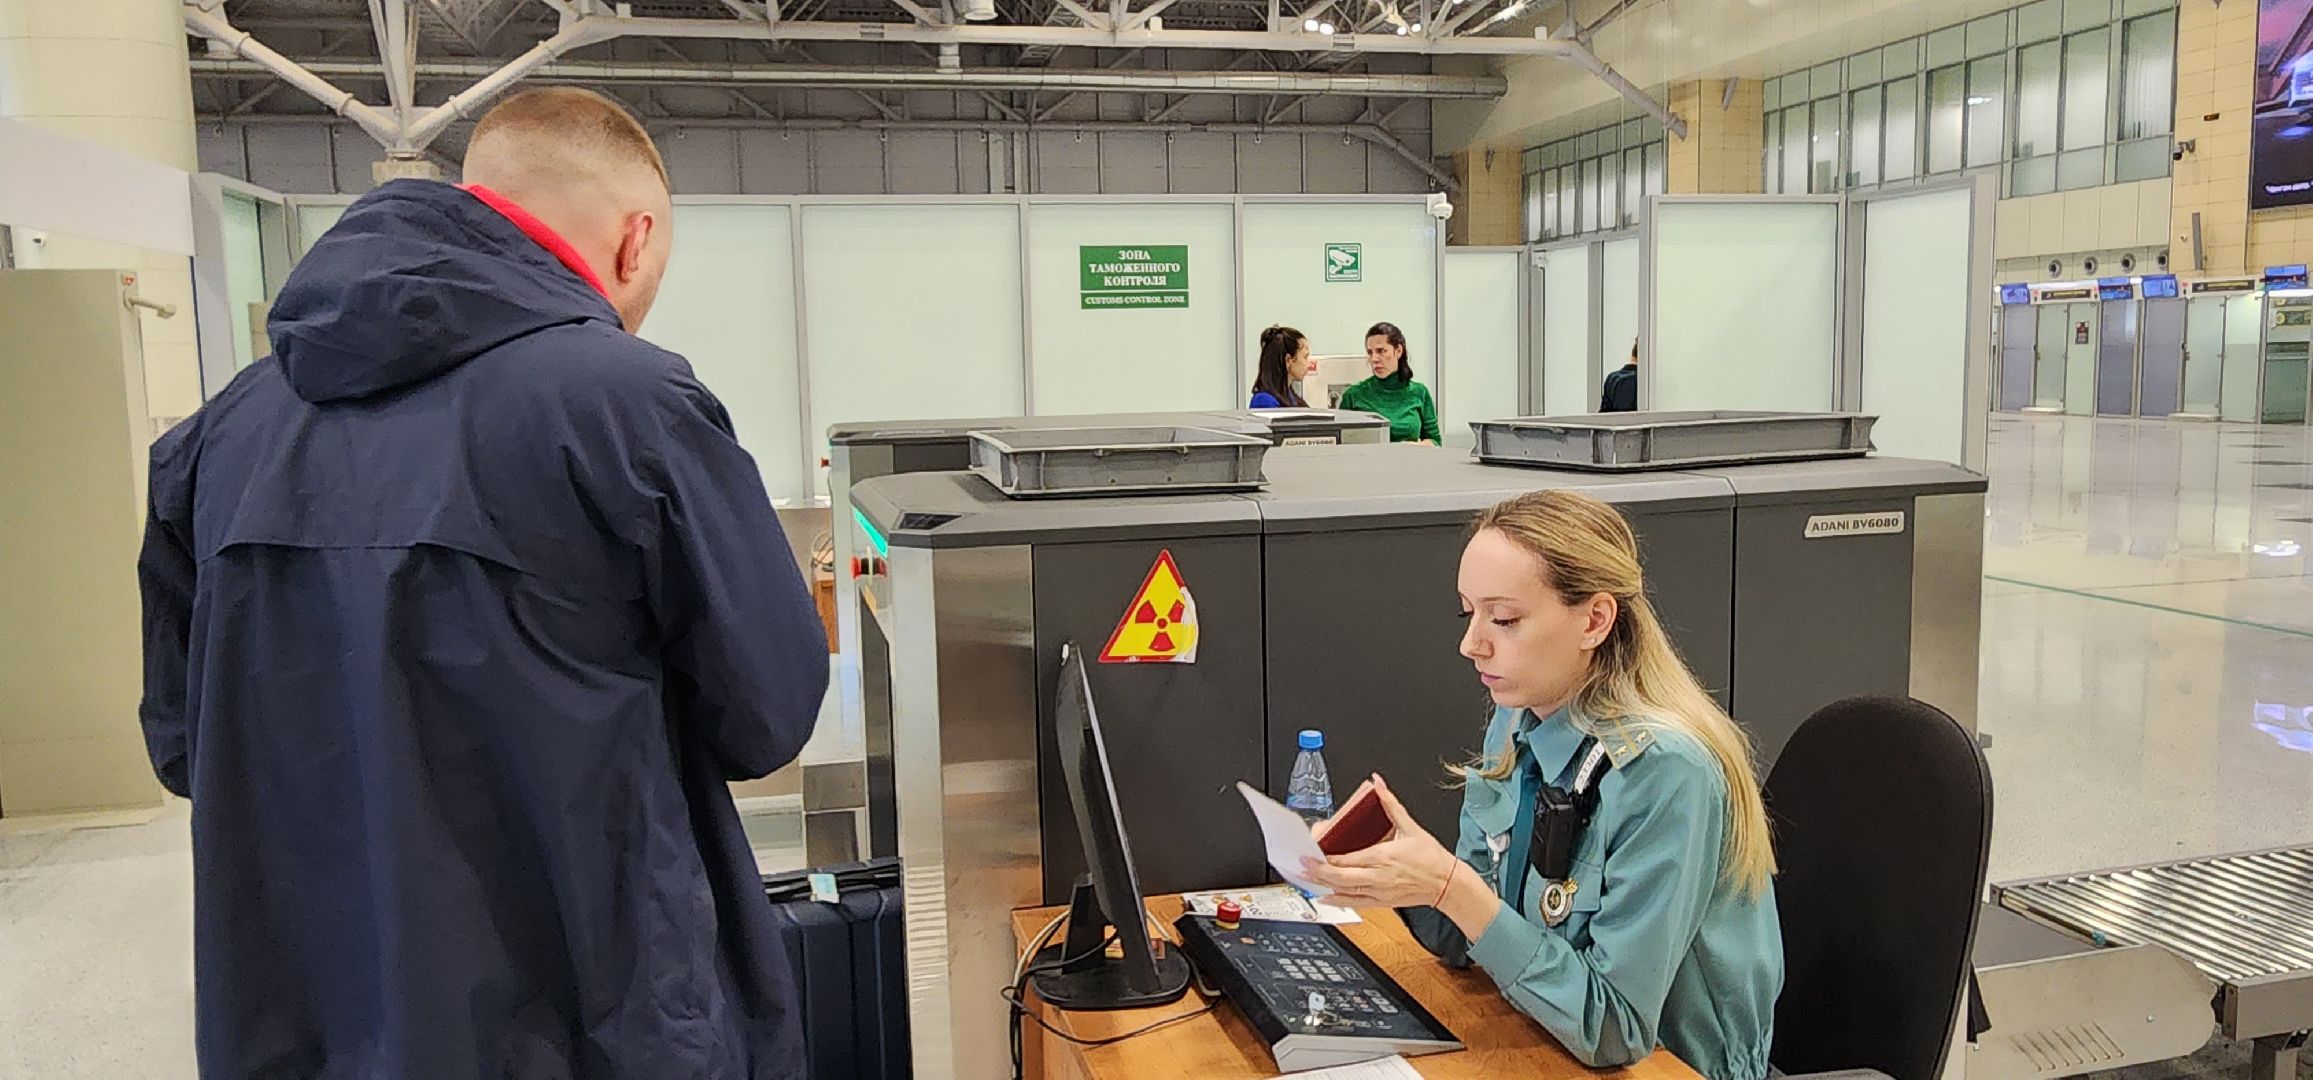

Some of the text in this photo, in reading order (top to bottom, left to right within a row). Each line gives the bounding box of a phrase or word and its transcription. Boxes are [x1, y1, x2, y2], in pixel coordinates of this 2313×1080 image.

[1118, 250, 1151, 260] ЗОНА
[1089, 263, 1181, 273] ТАМОЖЕННОГО
[1104, 276, 1167, 286] КОНТРОЛЯ
[1124, 296, 1162, 304] CONTROL
[1812, 521, 1849, 532] ADANI
